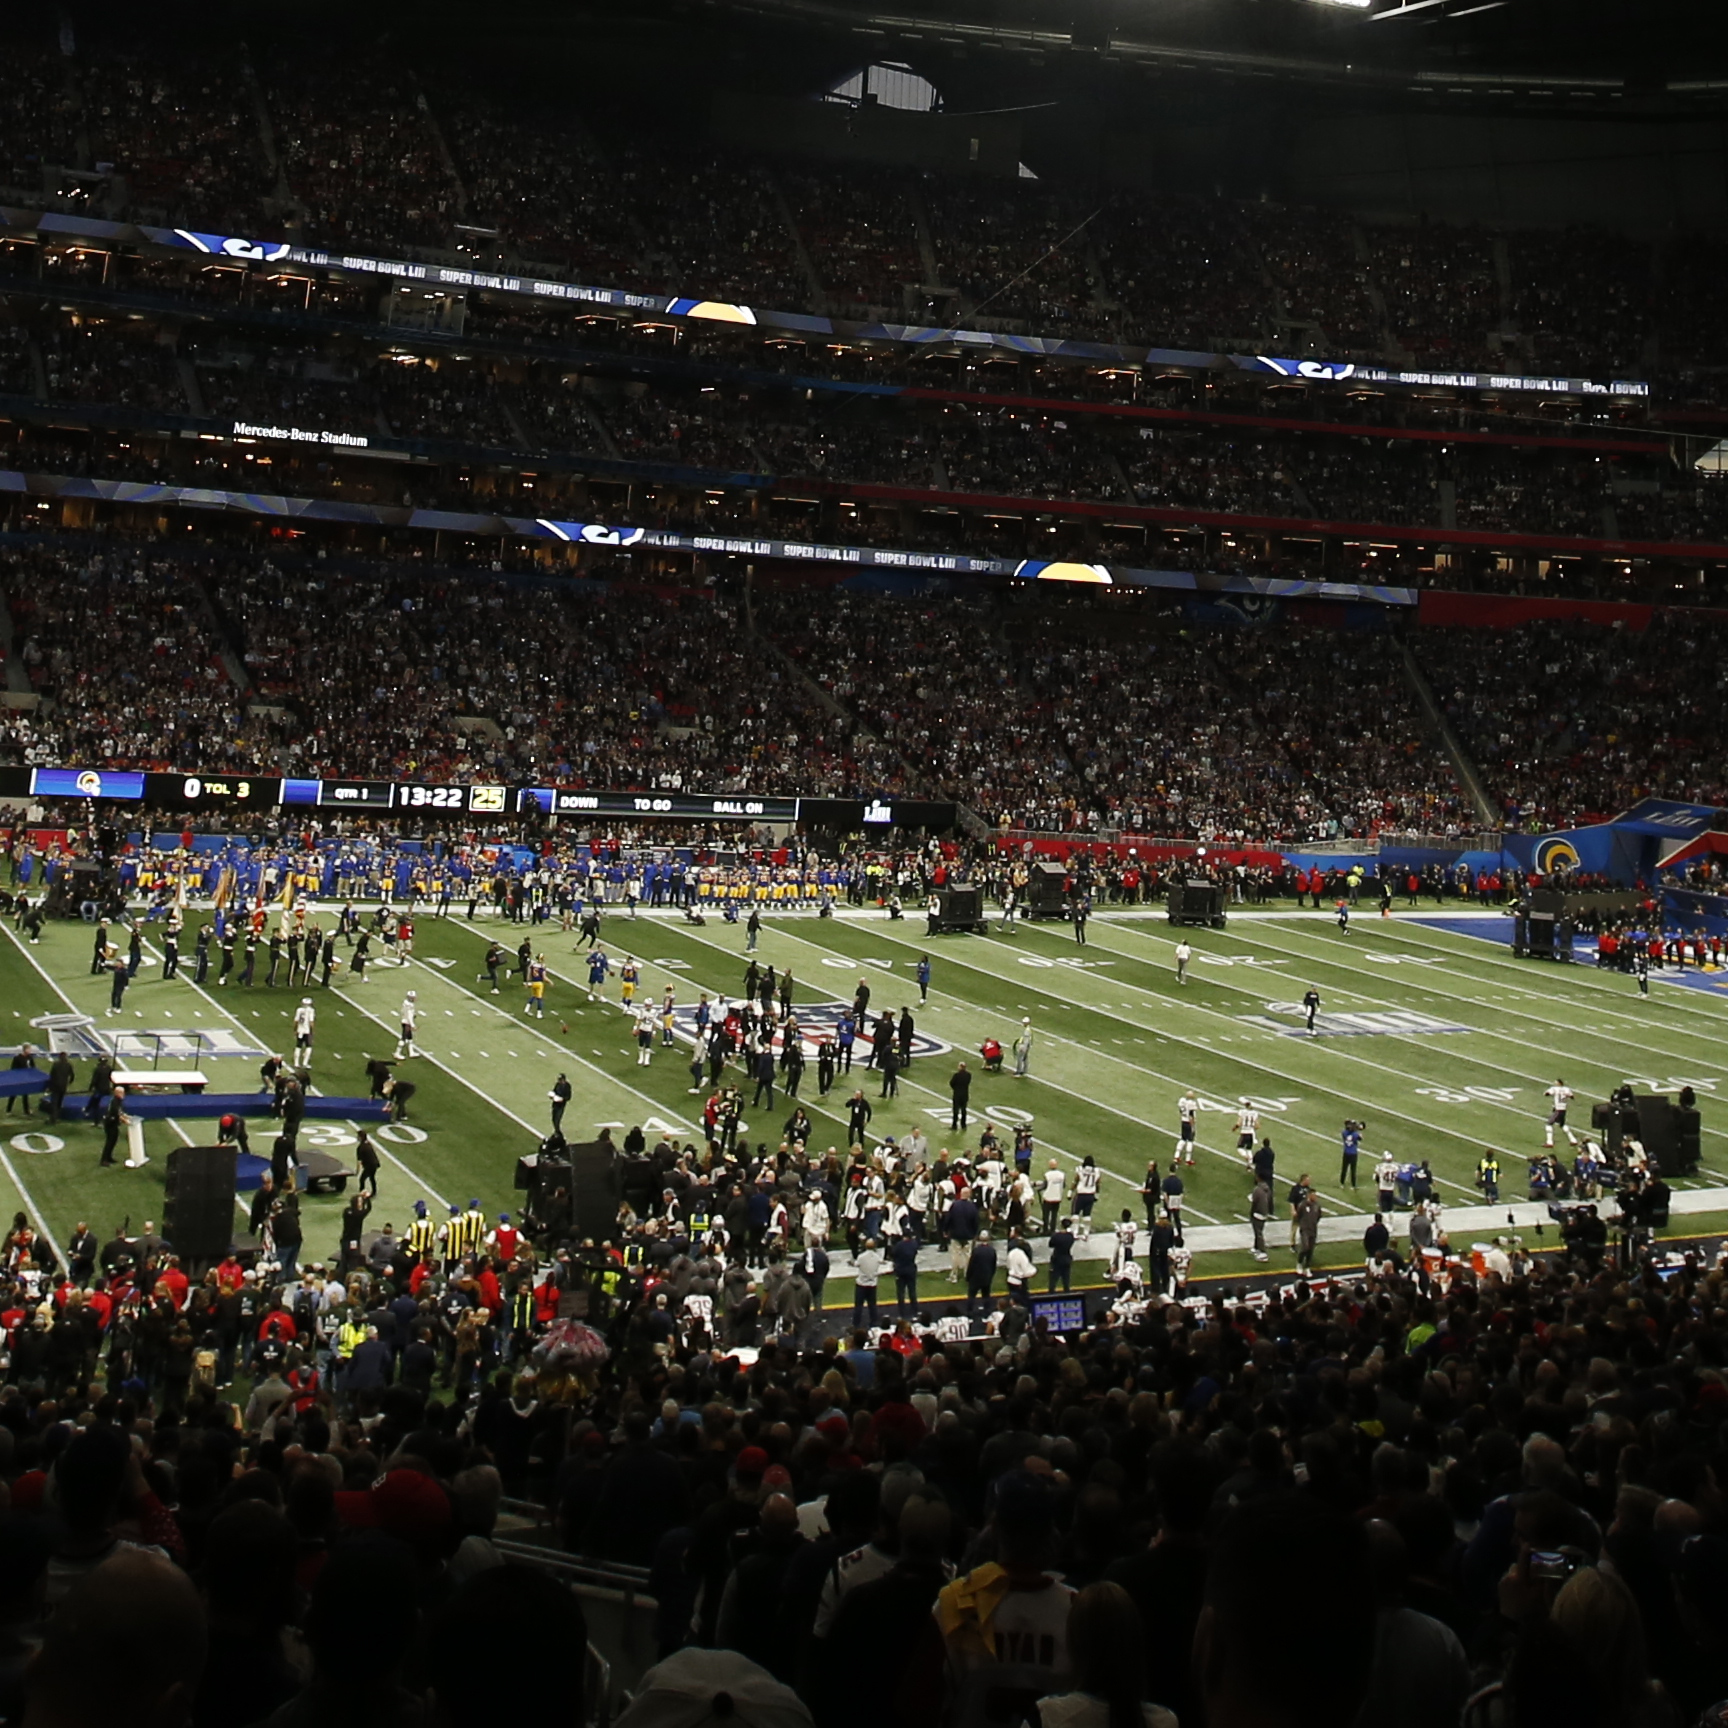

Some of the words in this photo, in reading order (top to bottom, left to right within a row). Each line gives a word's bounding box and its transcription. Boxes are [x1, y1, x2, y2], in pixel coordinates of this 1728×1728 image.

[342, 256, 376, 272] SUPER
[377, 261, 406, 276] BOWL
[408, 264, 426, 279] LIII
[439, 269, 472, 284] SUPER
[473, 274, 502, 289] BOWL
[503, 278, 520, 292] LIII
[533, 282, 566, 297] SUPER
[566, 286, 594, 301] BOWL
[594, 290, 612, 304] LIII
[1399, 371, 1430, 384] SUPER
[1431, 373, 1459, 386] BOWL
[1460, 375, 1477, 387] LIII
[1490, 375, 1522, 389] SUPER
[1523, 378, 1551, 391] BOWL
[1552, 380, 1569, 393] LIII
[233, 421, 318, 443] Mercedes-Benz
[320, 430, 369, 447] Stadium
[693, 536, 724, 551] SUPER
[726, 539, 752, 553] BOWL
[754, 541, 771, 555] LIII
[783, 543, 814, 557] SUPER
[815, 546, 841, 560] BOWL
[842, 548, 860, 562] LIII
[874, 551, 907, 566] SUPER
[908, 554, 937, 568] BOWL
[938, 555, 956, 569] LIII
[183, 777, 202, 799] 0
[203, 782, 230, 795] TOL
[235, 781, 250, 798] 3
[333, 787, 359, 800] QTR
[361, 788, 369, 800] 1
[398, 786, 464, 808] 13:22
[472, 788, 503, 809] 25
[559, 795, 600, 809] DOWN
[634, 797, 651, 811] TO
[653, 798, 672, 812] GO
[712, 801, 743, 814] BALL
[746, 802, 763, 815] ON
